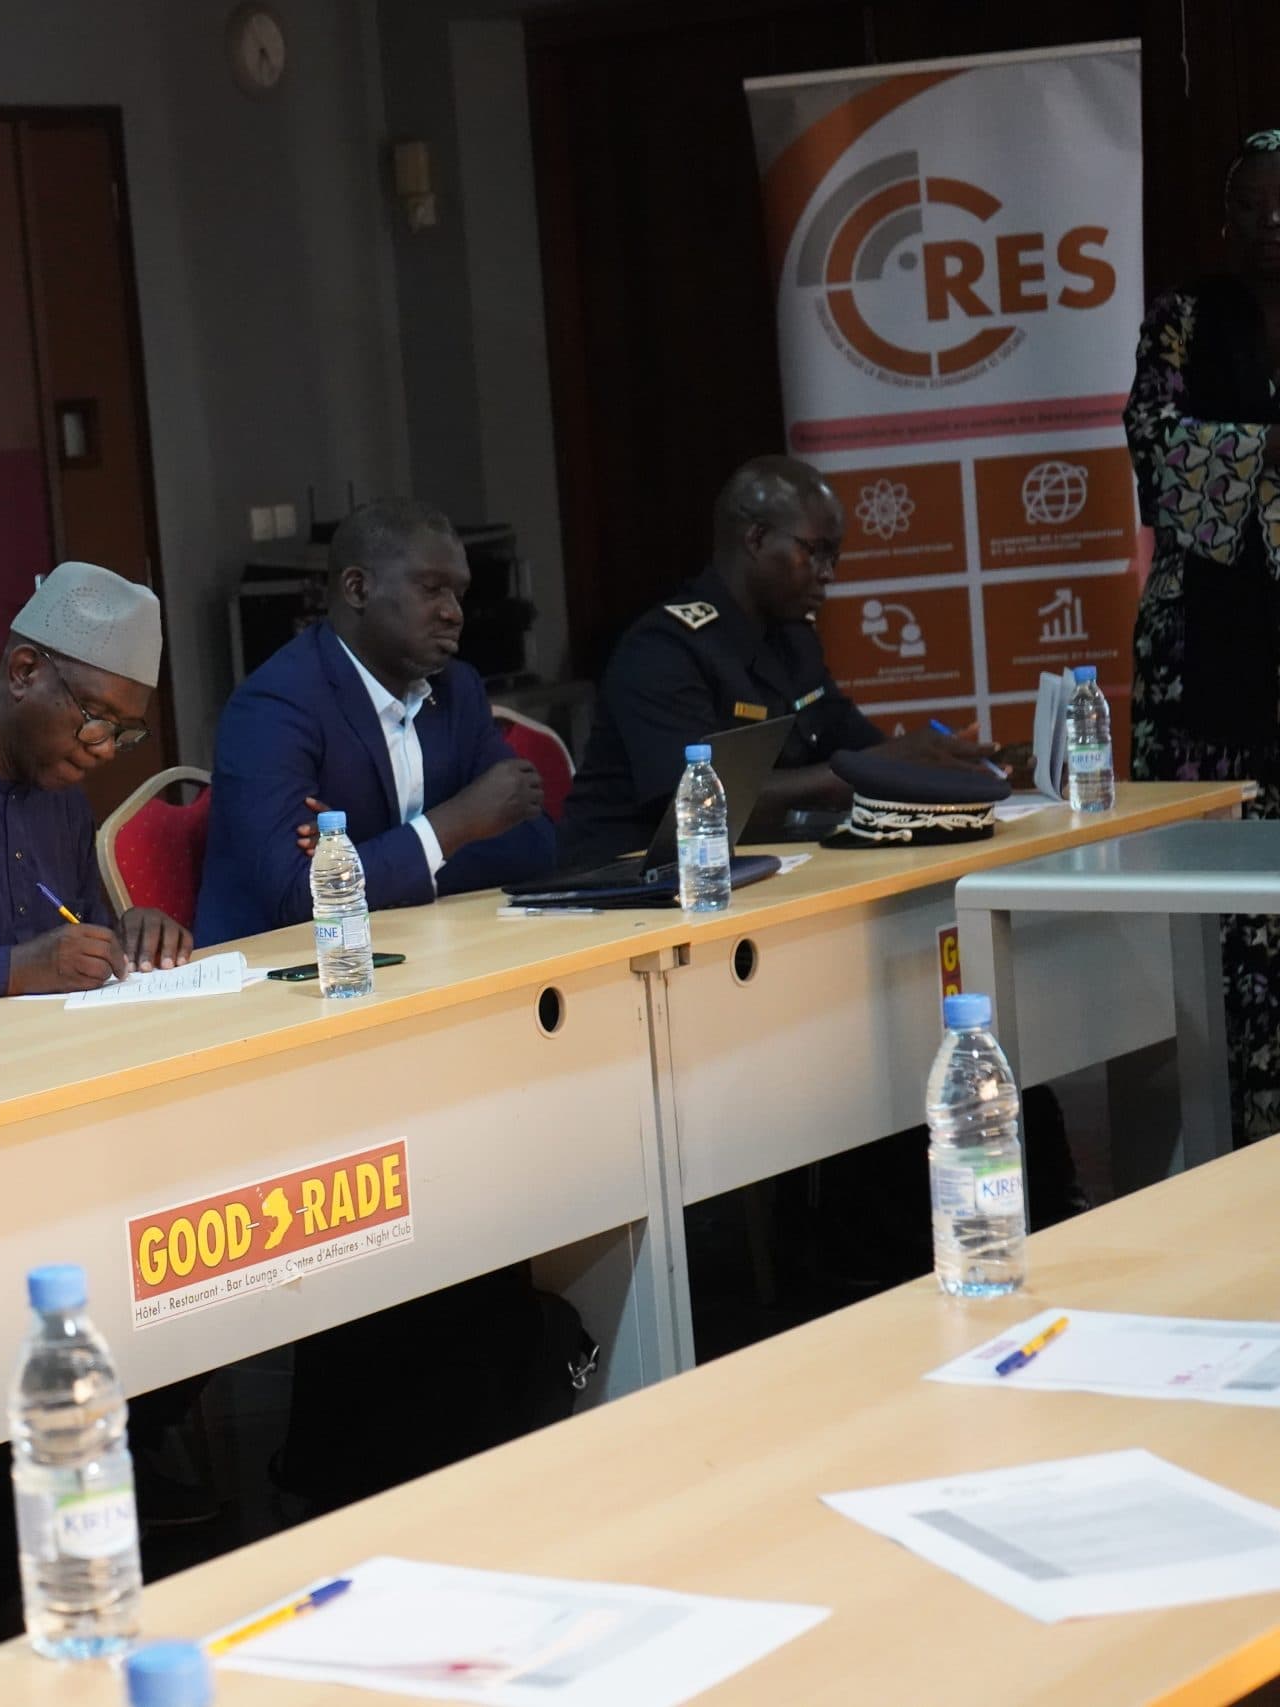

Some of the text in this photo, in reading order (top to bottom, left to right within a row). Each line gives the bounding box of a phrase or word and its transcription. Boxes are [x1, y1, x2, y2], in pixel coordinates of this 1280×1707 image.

[135, 1304, 162, 1322] Hôtel
[169, 1285, 219, 1310] Restaurant
[226, 1277, 242, 1292] Bar
[245, 1267, 278, 1284] Lounge
[366, 1229, 390, 1247] Night
[392, 1222, 411, 1239] Club
[139, 1153, 403, 1286] GOOD RADE
